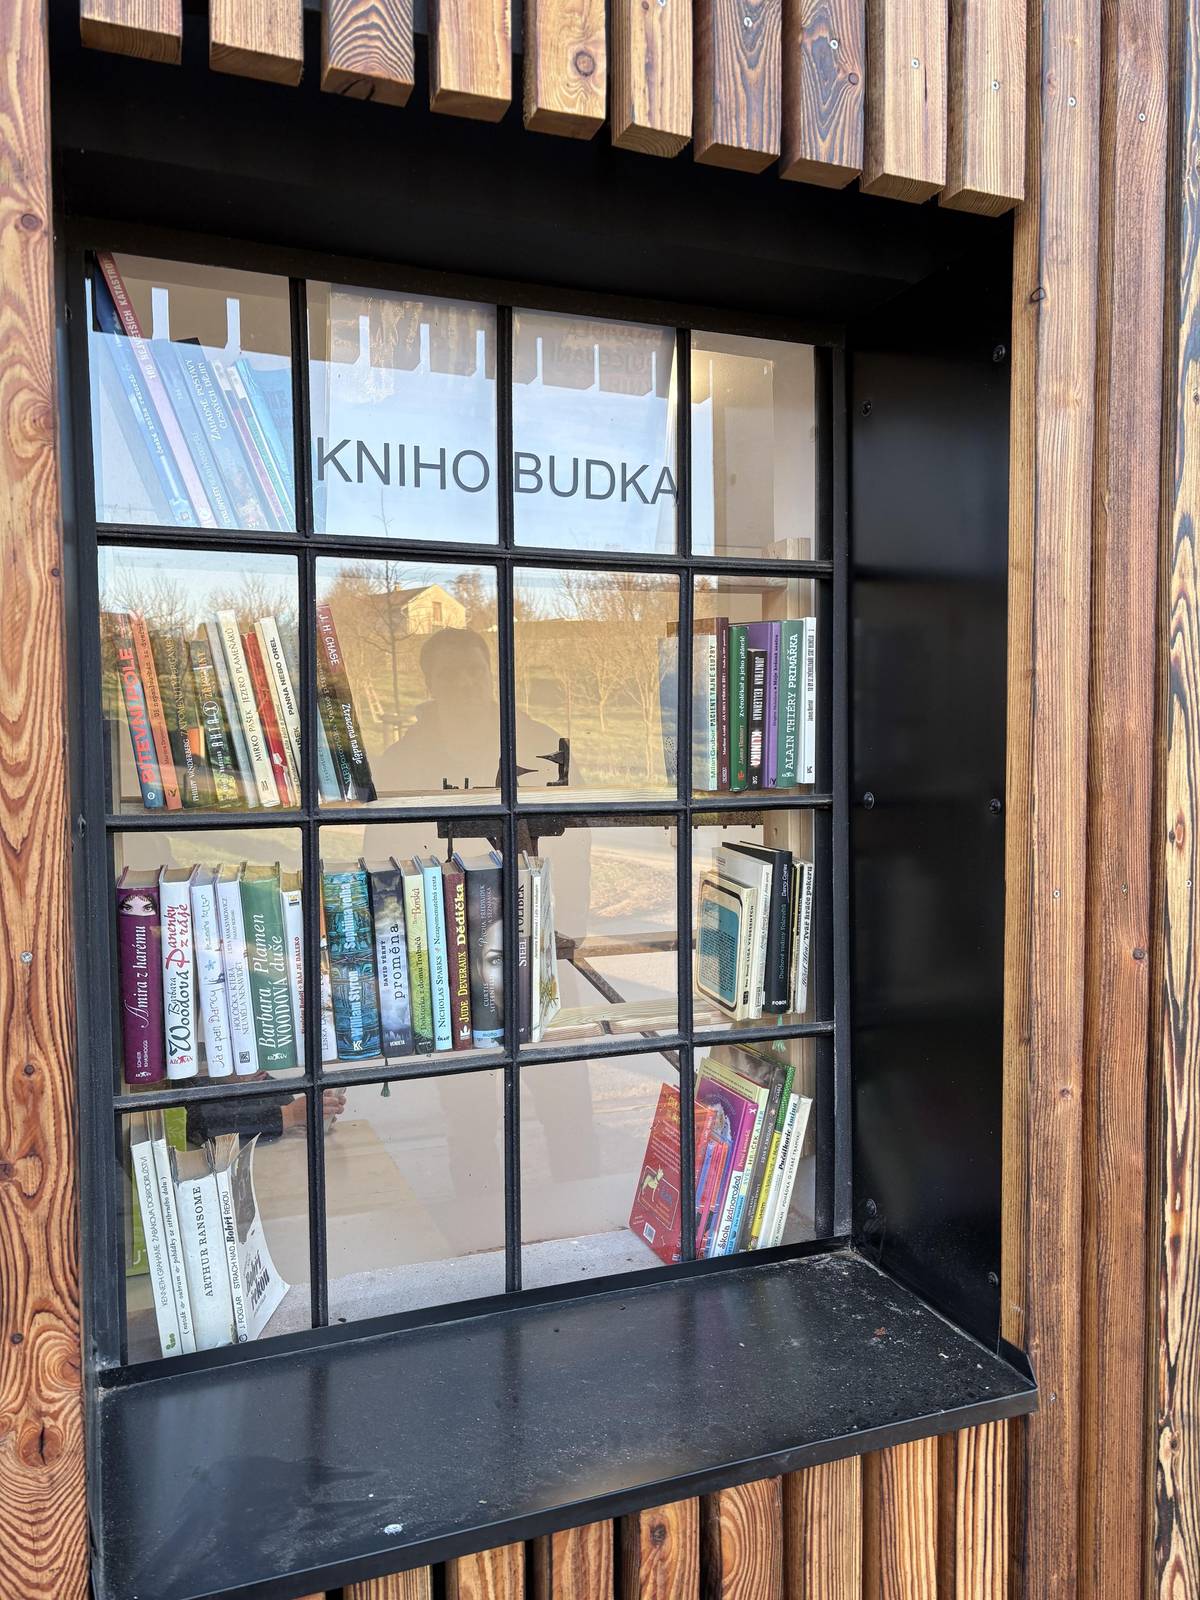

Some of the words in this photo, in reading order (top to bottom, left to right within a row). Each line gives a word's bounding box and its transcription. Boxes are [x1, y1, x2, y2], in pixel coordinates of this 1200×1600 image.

[317, 437, 490, 492] KNIHO
[514, 451, 678, 505] BUDKA
[322, 624, 331, 634] H.
[269, 637, 279, 660] OREL
[324, 636, 340, 666] CHASE
[785, 634, 797, 688] PRIMÁŘKA
[118, 646, 141, 701] POLE
[275, 660, 286, 686] NEBO
[753, 656, 764, 684] JONATHAN
[236, 675, 250, 703] JEZERO
[281, 686, 294, 715] PANNA
[752, 688, 763, 720] KELLERMAN
[243, 709, 256, 732] PAŠEK
[340, 702, 358, 739] Ztracená
[250, 734, 262, 762] MIRKO
[348, 738, 364, 765] naděje
[750, 731, 762, 766] KLINIKA
[785, 735, 794, 768] ALAIN
[804, 865, 813, 895] pokeru
[452, 883, 466, 945] Dědička
[131, 925, 147, 968] harému
[180, 939, 188, 947] z
[249, 913, 269, 974] Plamen
[266, 935, 285, 972] duše
[387, 923, 405, 999] proměna
[416, 966, 424, 988] domu
[434, 955, 443, 984] SPARKS
[455, 951, 468, 995] DEVERAUX
[166, 976, 180, 1015] Barbara
[347, 969, 360, 1000] Styron
[123, 981, 149, 1028] Amira
[165, 969, 191, 1056] Woodová
[254, 987, 276, 1048] Barbara
[267, 976, 293, 1047] WOODOVÁ
[349, 1001, 364, 1036] William
[418, 995, 427, 1029] Doktorka
[458, 999, 469, 1022] JUDE
[776, 1128, 793, 1170] Pučálkovic
[786, 1102, 799, 1129] Amina
[722, 1173, 742, 1222] jednorožců
[191, 1185, 207, 1245] RANSOME
[716, 1223, 731, 1250] Škola
[199, 1247, 213, 1297] ARTHUR
[231, 1261, 241, 1289] STRACH
[157, 1276, 168, 1306] KENNETH
[235, 1295, 244, 1323] FOGLAR
